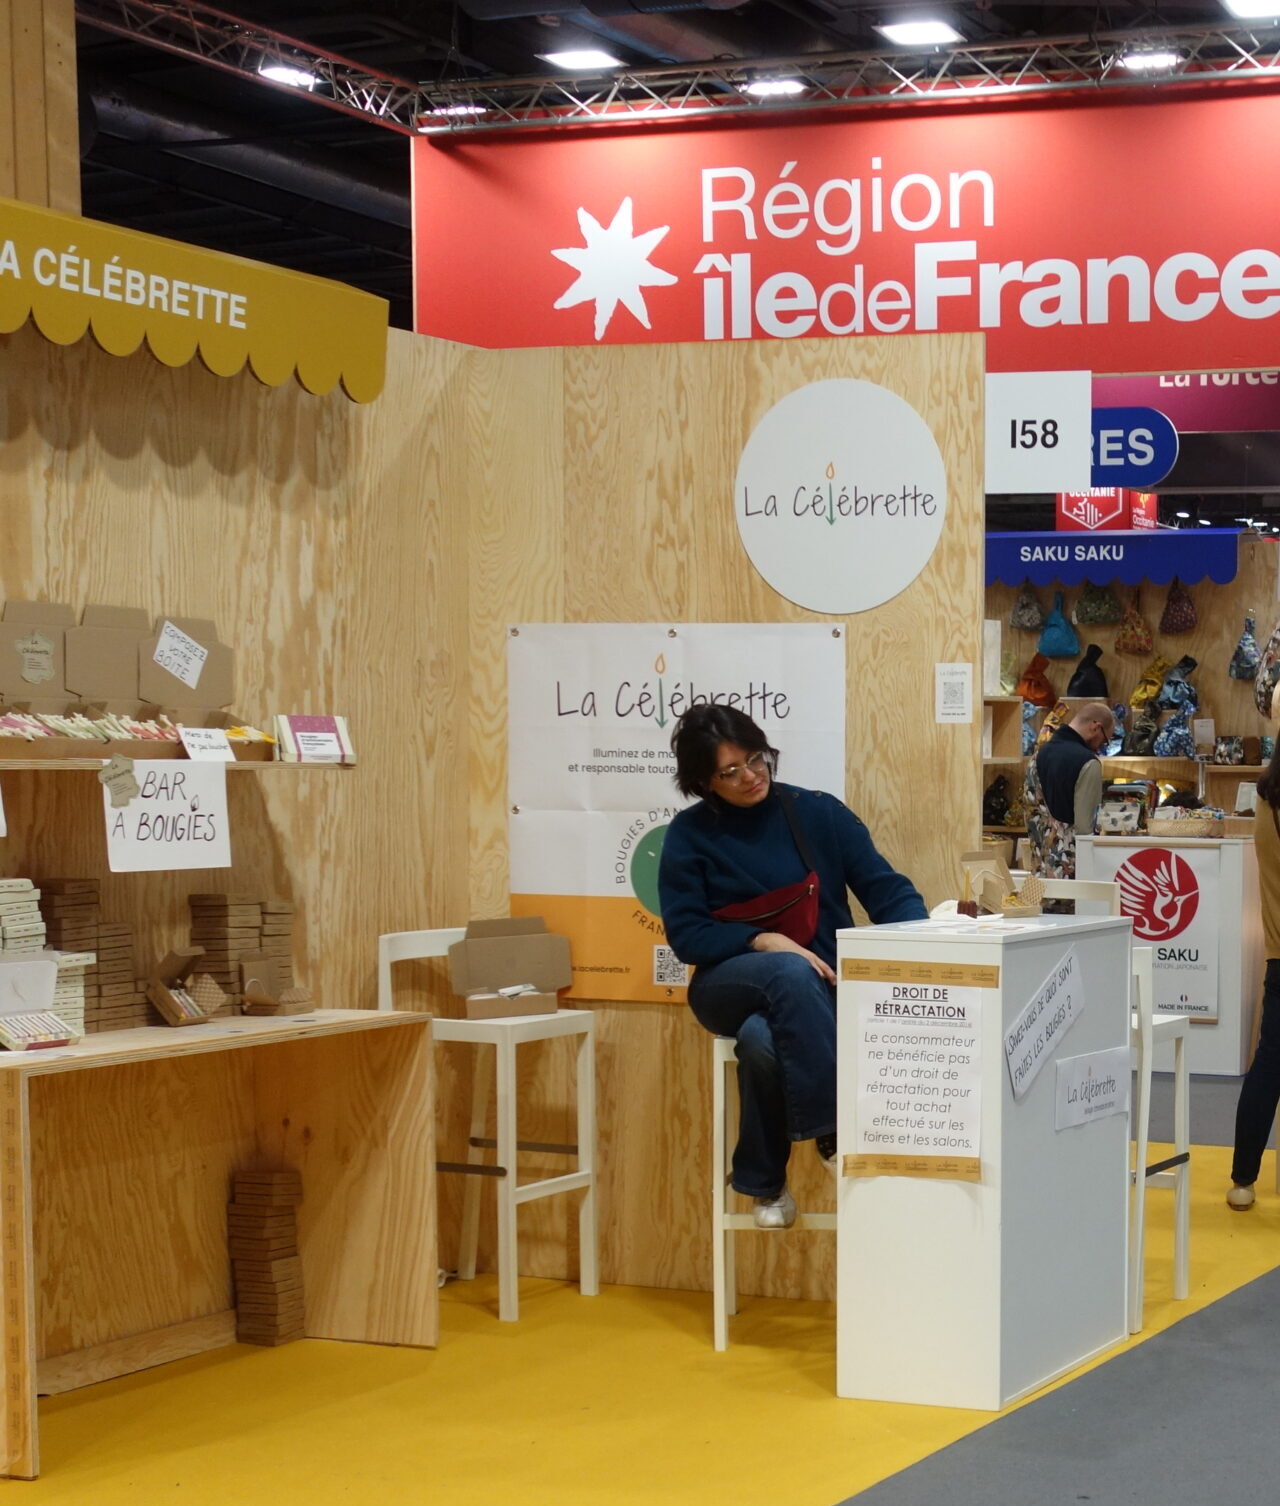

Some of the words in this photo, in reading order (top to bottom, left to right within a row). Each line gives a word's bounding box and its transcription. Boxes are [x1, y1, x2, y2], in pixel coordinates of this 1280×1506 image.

[700, 155, 996, 256] Région
[33, 245, 248, 330] CÉLÉBRETTE
[1010, 418, 1060, 450] I58
[744, 485, 778, 518] La
[792, 481, 938, 527] Célébrette
[1020, 546, 1069, 562] SAKU
[1074, 545, 1125, 562] SAKU
[556, 681, 597, 717] La
[614, 677, 791, 729] Célébrette
[593, 748, 639, 760] Illuminez
[641, 748, 656, 760] de
[568, 763, 578, 773] et
[581, 762, 646, 776] responsable
[141, 770, 187, 801] BAR
[112, 811, 126, 840] A
[136, 812, 216, 842] BOUGIES
[614, 818, 646, 885] BOUGIES
[1157, 947, 1199, 962] SAKU
[892, 986, 929, 999] DROIT
[933, 988, 949, 1000] DE
[1038, 998, 1045, 1015] DE
[1059, 956, 1074, 987] SONT
[874, 999, 966, 1018] RÉTRACTATION
[1158, 1003, 1176, 1011] MADE
[1184, 1004, 1209, 1012] FRANCE
[864, 1032, 878, 1043] Le
[881, 1034, 976, 1048] consommateur
[1033, 1034, 1044, 1059] LES
[867, 1050, 884, 1060] ne
[887, 1049, 945, 1063] bénéficie
[949, 1054, 971, 1065] pas
[879, 1065, 908, 1078] d'un
[911, 1067, 940, 1080] droit
[942, 1069, 959, 1081] de
[866, 1081, 939, 1096] rétractation
[942, 1087, 972, 1099] pour
[1067, 1085, 1078, 1104] La
[1080, 1074, 1117, 1103] Célébrette
[886, 1099, 911, 1111] tout
[913, 1101, 952, 1113] achat
[872, 1115, 925, 1129] effectué
[928, 1120, 946, 1130] sur
[948, 1119, 965, 1131] les
[863, 1131, 895, 1144] foires
[897, 1134, 911, 1145] et
[913, 1133, 930, 1146] les
[932, 1136, 973, 1149] salons.
